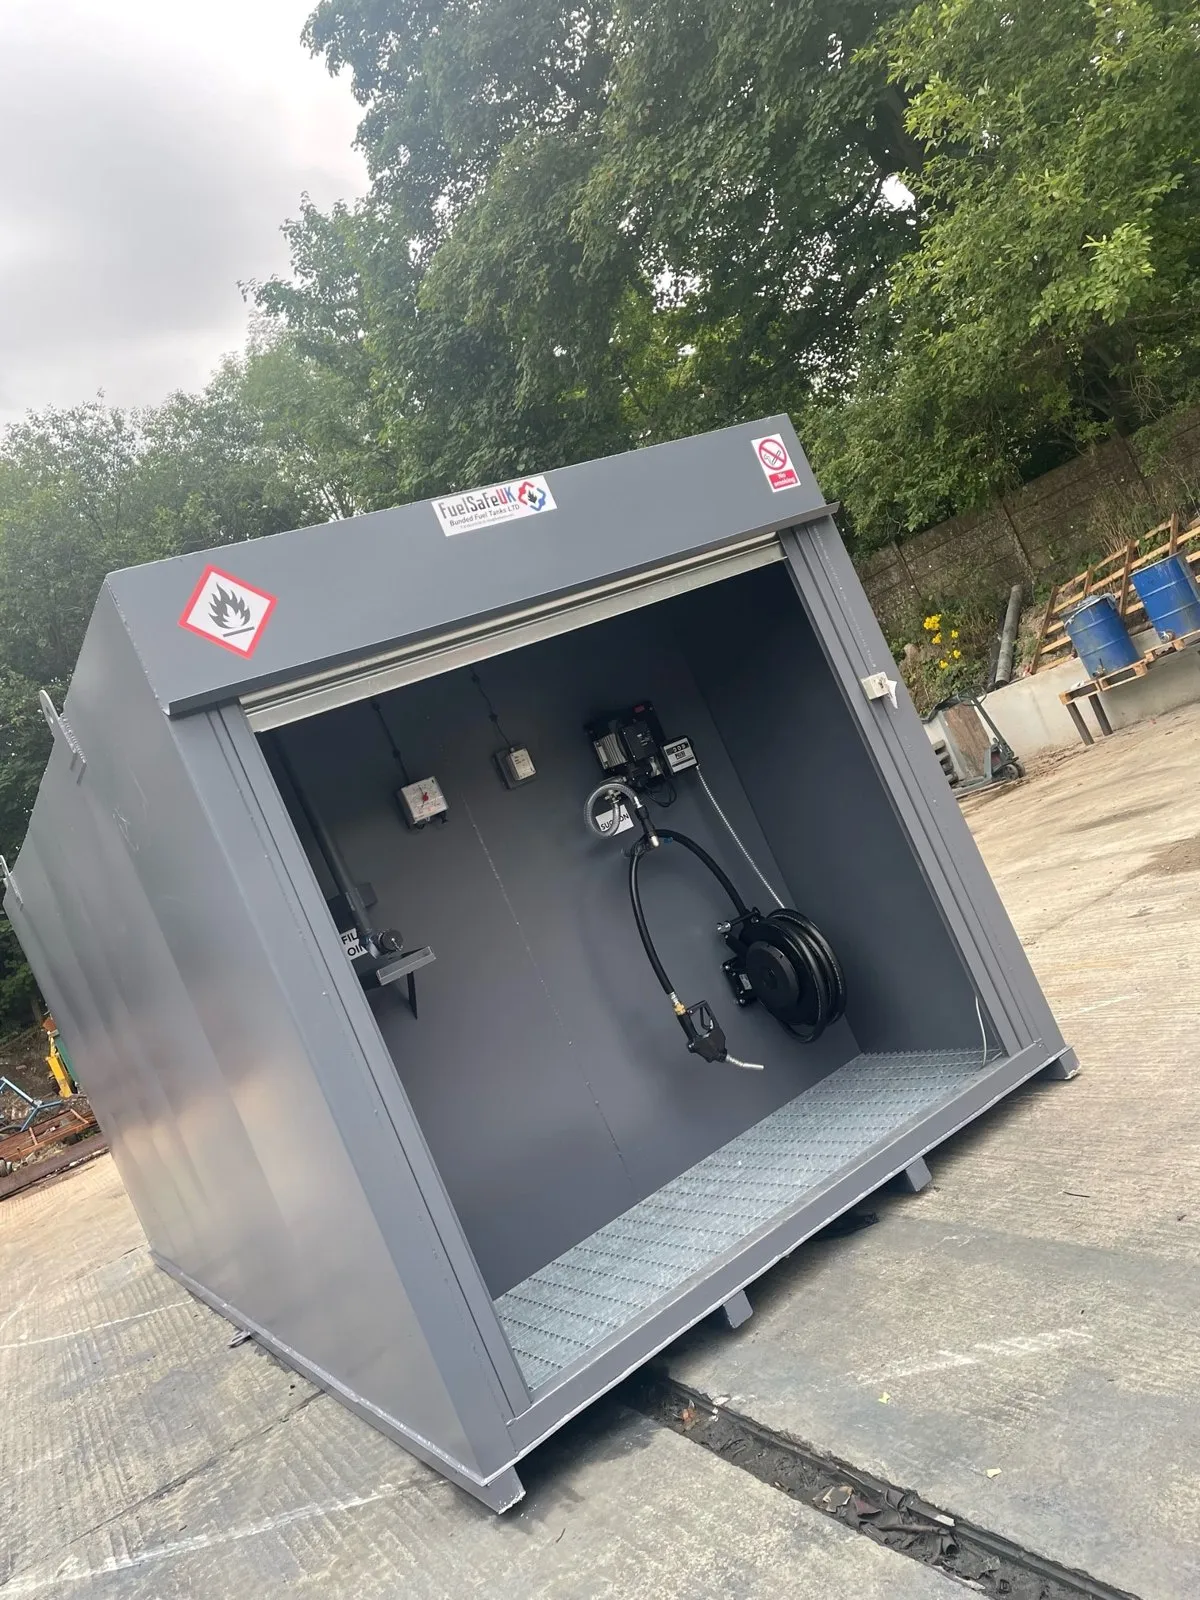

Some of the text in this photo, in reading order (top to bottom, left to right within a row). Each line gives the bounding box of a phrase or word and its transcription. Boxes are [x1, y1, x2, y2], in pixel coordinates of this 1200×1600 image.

[450, 514, 474, 527] Bunded
[474, 511, 488, 522] Fuel
[490, 507, 507, 518] Tanks
[508, 504, 520, 513] LTD
[600, 813, 629, 830] SUCON
[341, 932, 358, 944] FIL
